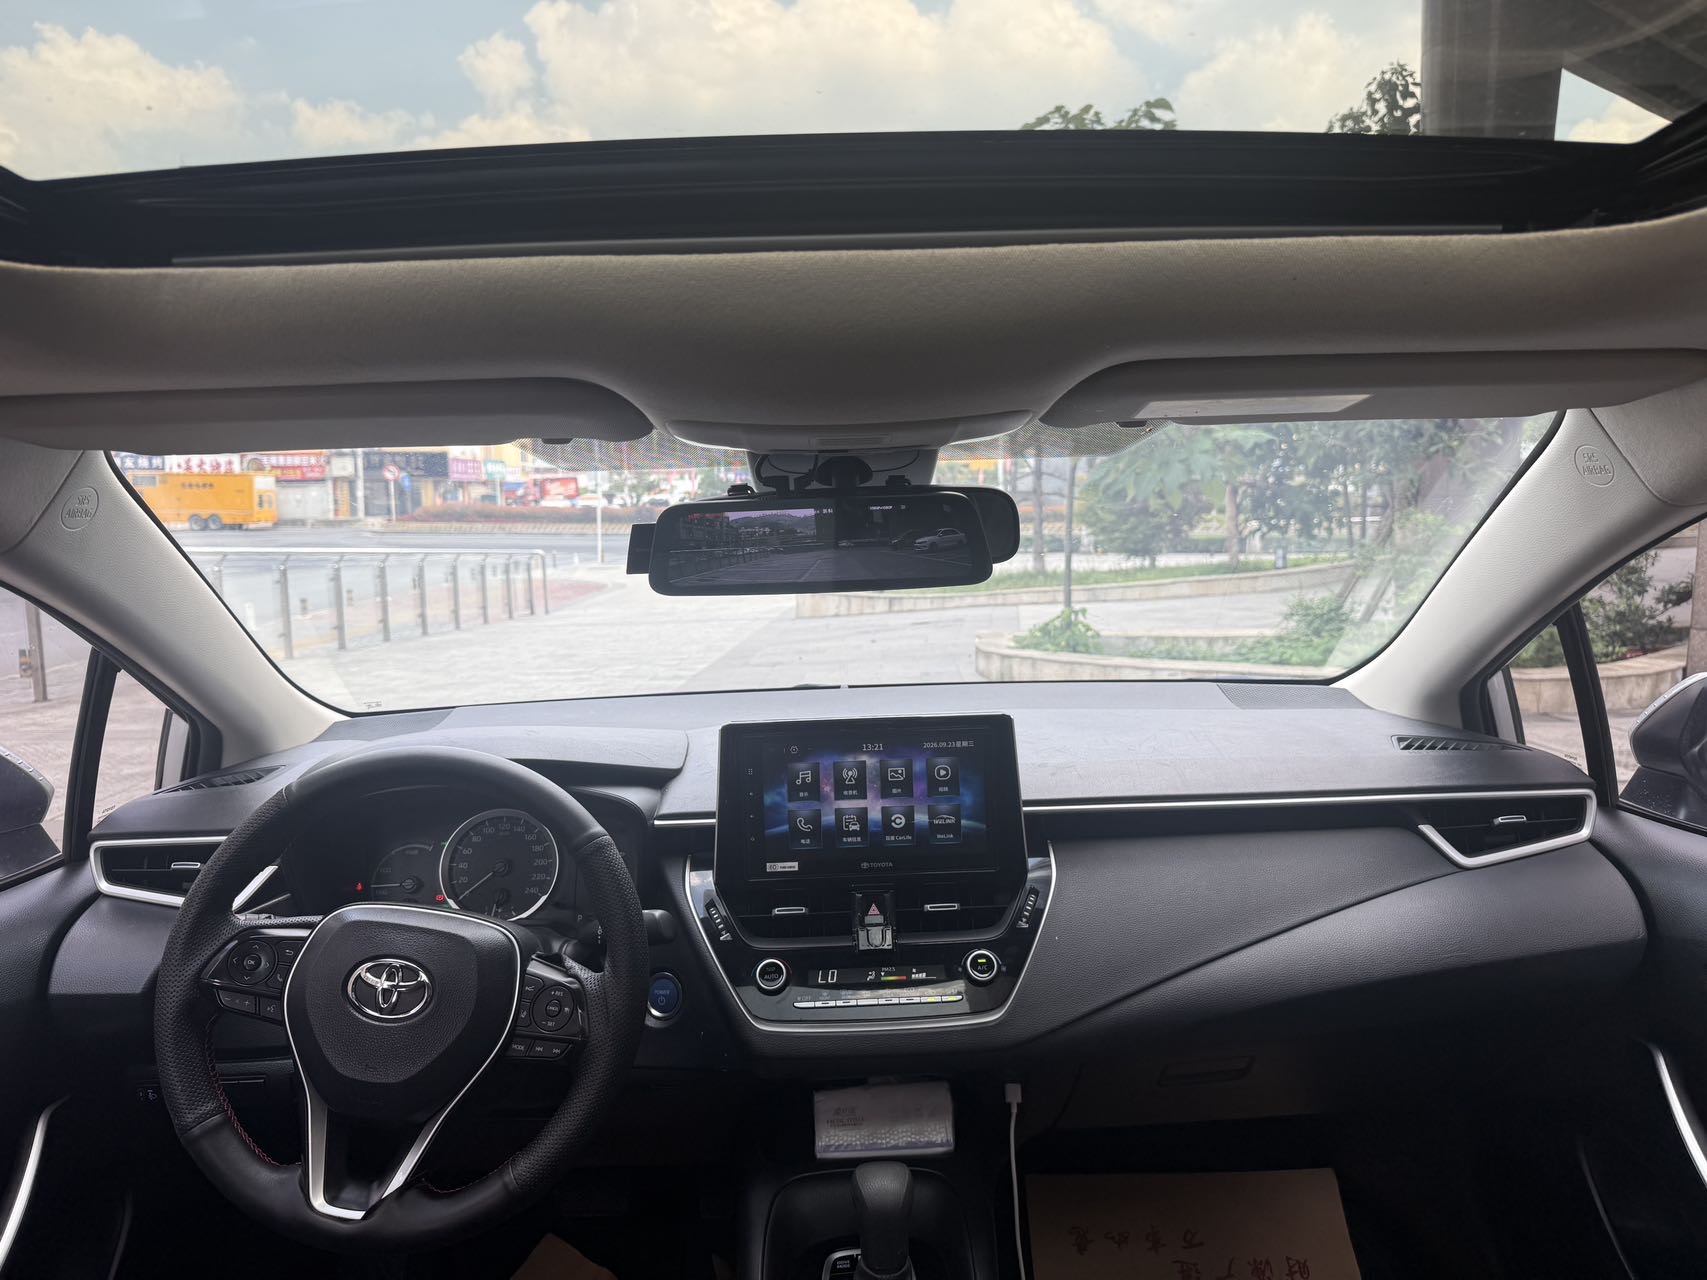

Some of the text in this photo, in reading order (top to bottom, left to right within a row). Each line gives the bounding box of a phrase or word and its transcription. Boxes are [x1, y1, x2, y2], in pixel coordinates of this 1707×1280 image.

[1582, 452, 1600, 464] SRS
[1582, 464, 1612, 476] AIRBAG
[76, 494, 91, 506] SRS
[65, 508, 92, 519] AIRBAG
[862, 743, 884, 751] 13:21
[525, 833, 537, 841] 160
[818, 969, 838, 983] LO
[512, 1043, 525, 1051] MODE
[1067, 1225, 1204, 1256] 万事如意
